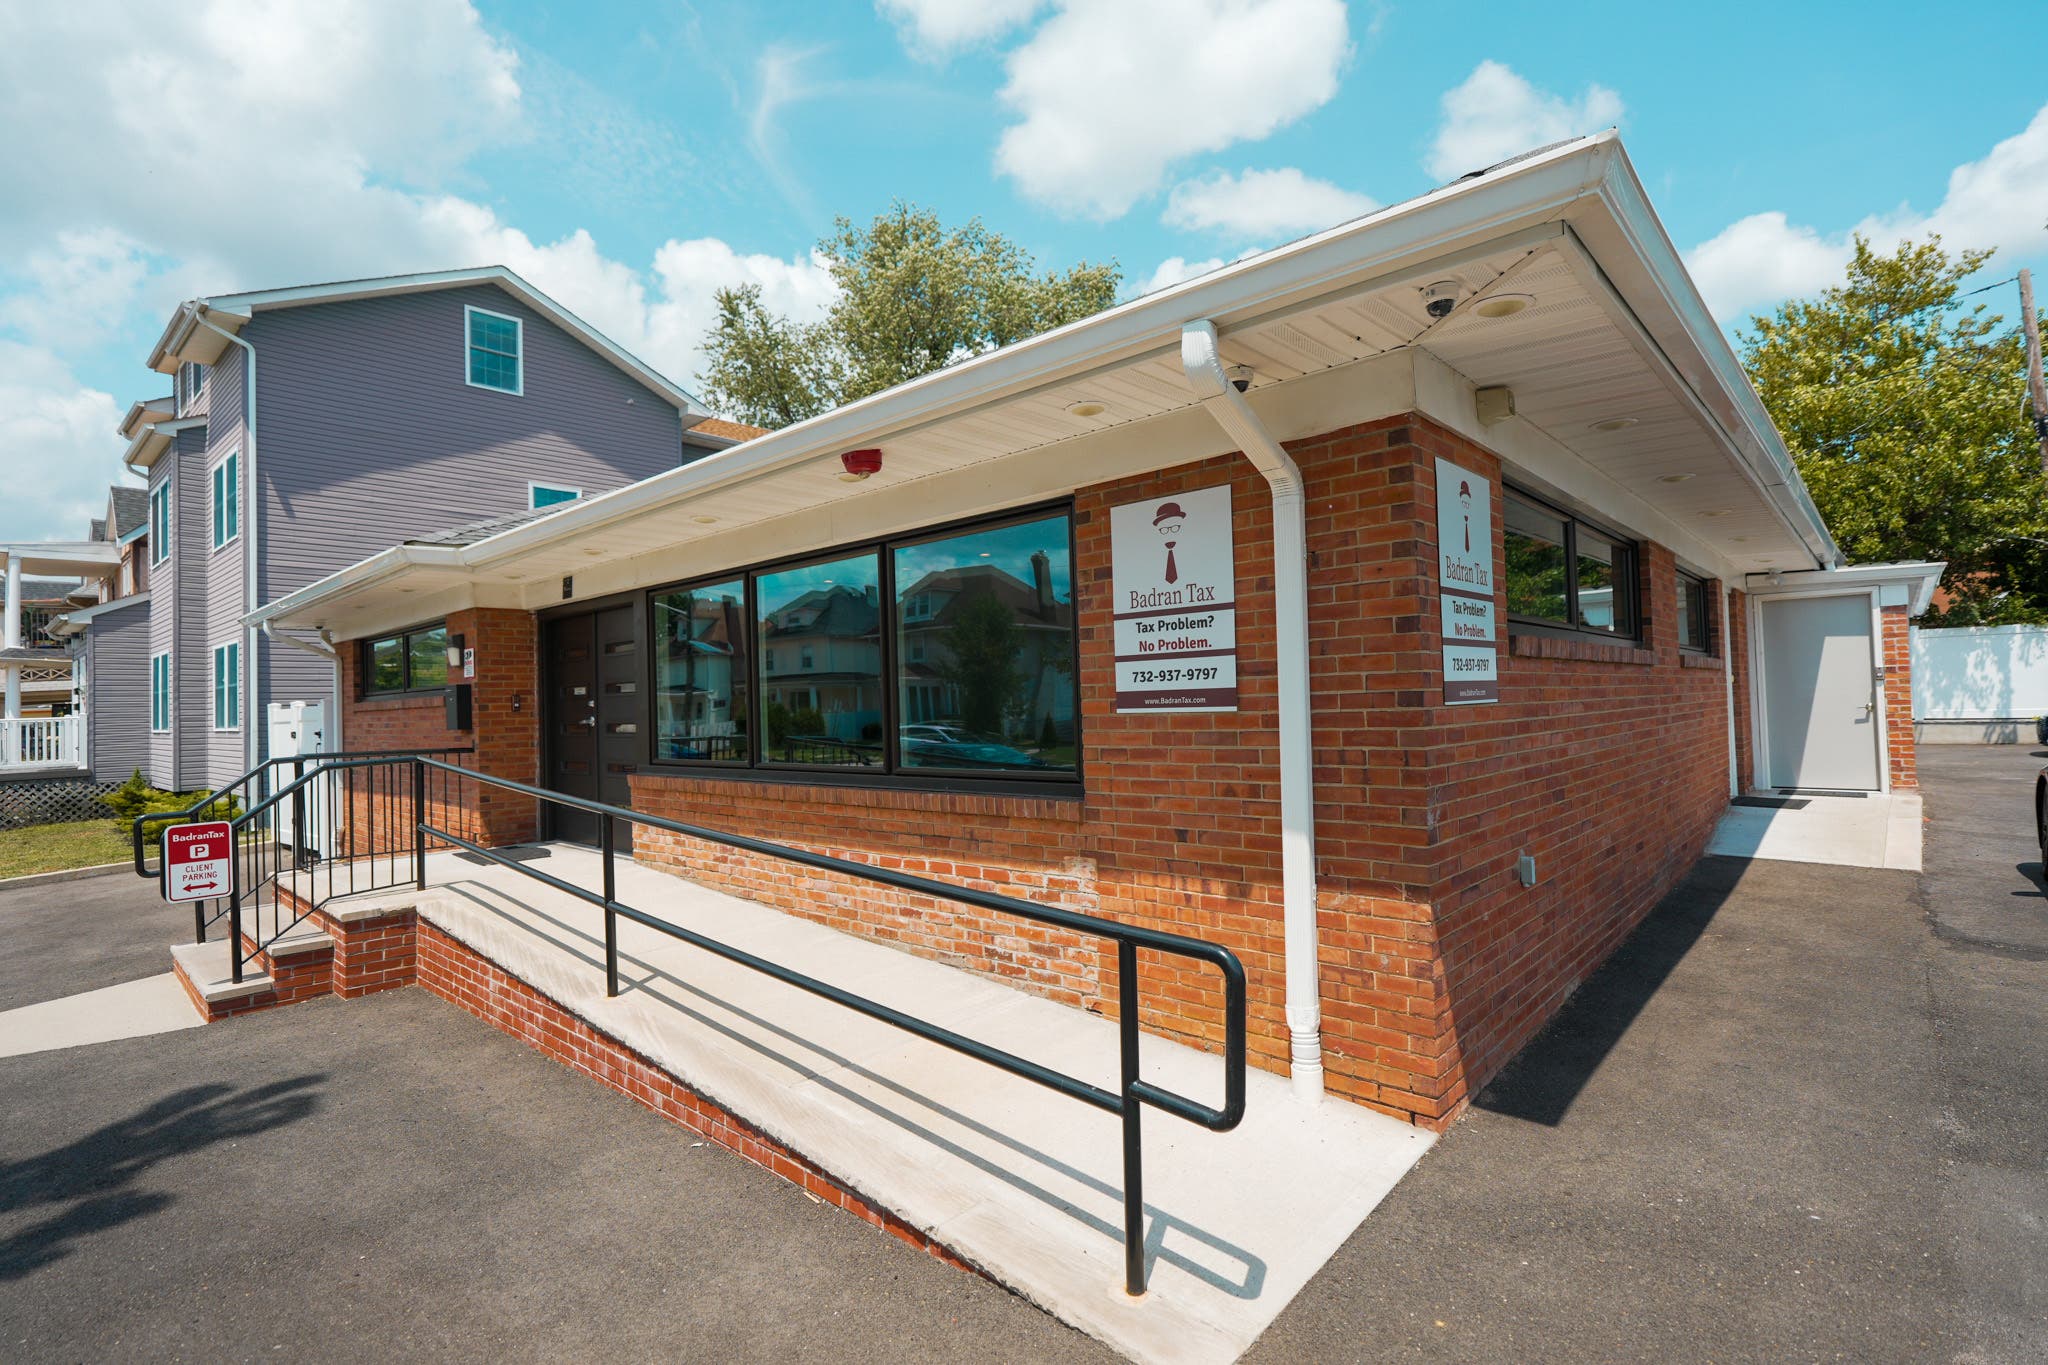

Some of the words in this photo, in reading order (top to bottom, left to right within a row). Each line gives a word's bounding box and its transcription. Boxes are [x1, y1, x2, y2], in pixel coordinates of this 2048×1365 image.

[1446, 555, 1474, 583] Badran
[1475, 562, 1488, 586] Tax
[1129, 588, 1183, 609] Badran
[1186, 583, 1215, 603] Tax
[1452, 600, 1462, 615] Tax
[1463, 602, 1487, 617] Problem?
[1136, 622, 1155, 633] Tax
[1158, 615, 1215, 632] Problem?
[1454, 622, 1463, 636] No
[1463, 623, 1487, 638] Problem.
[1139, 640, 1155, 652] No
[1158, 636, 1212, 651] Problem.
[1452, 657, 1489, 672] 732-937-9797
[1132, 667, 1218, 683] 732-937-9797
[1144, 697, 1206, 705] www.BadranTax.com
[172, 831, 225, 843] BadranTax
[194, 846, 206, 857] P
[185, 863, 214, 873] CLIENT
[182, 871, 218, 882] PARKING
